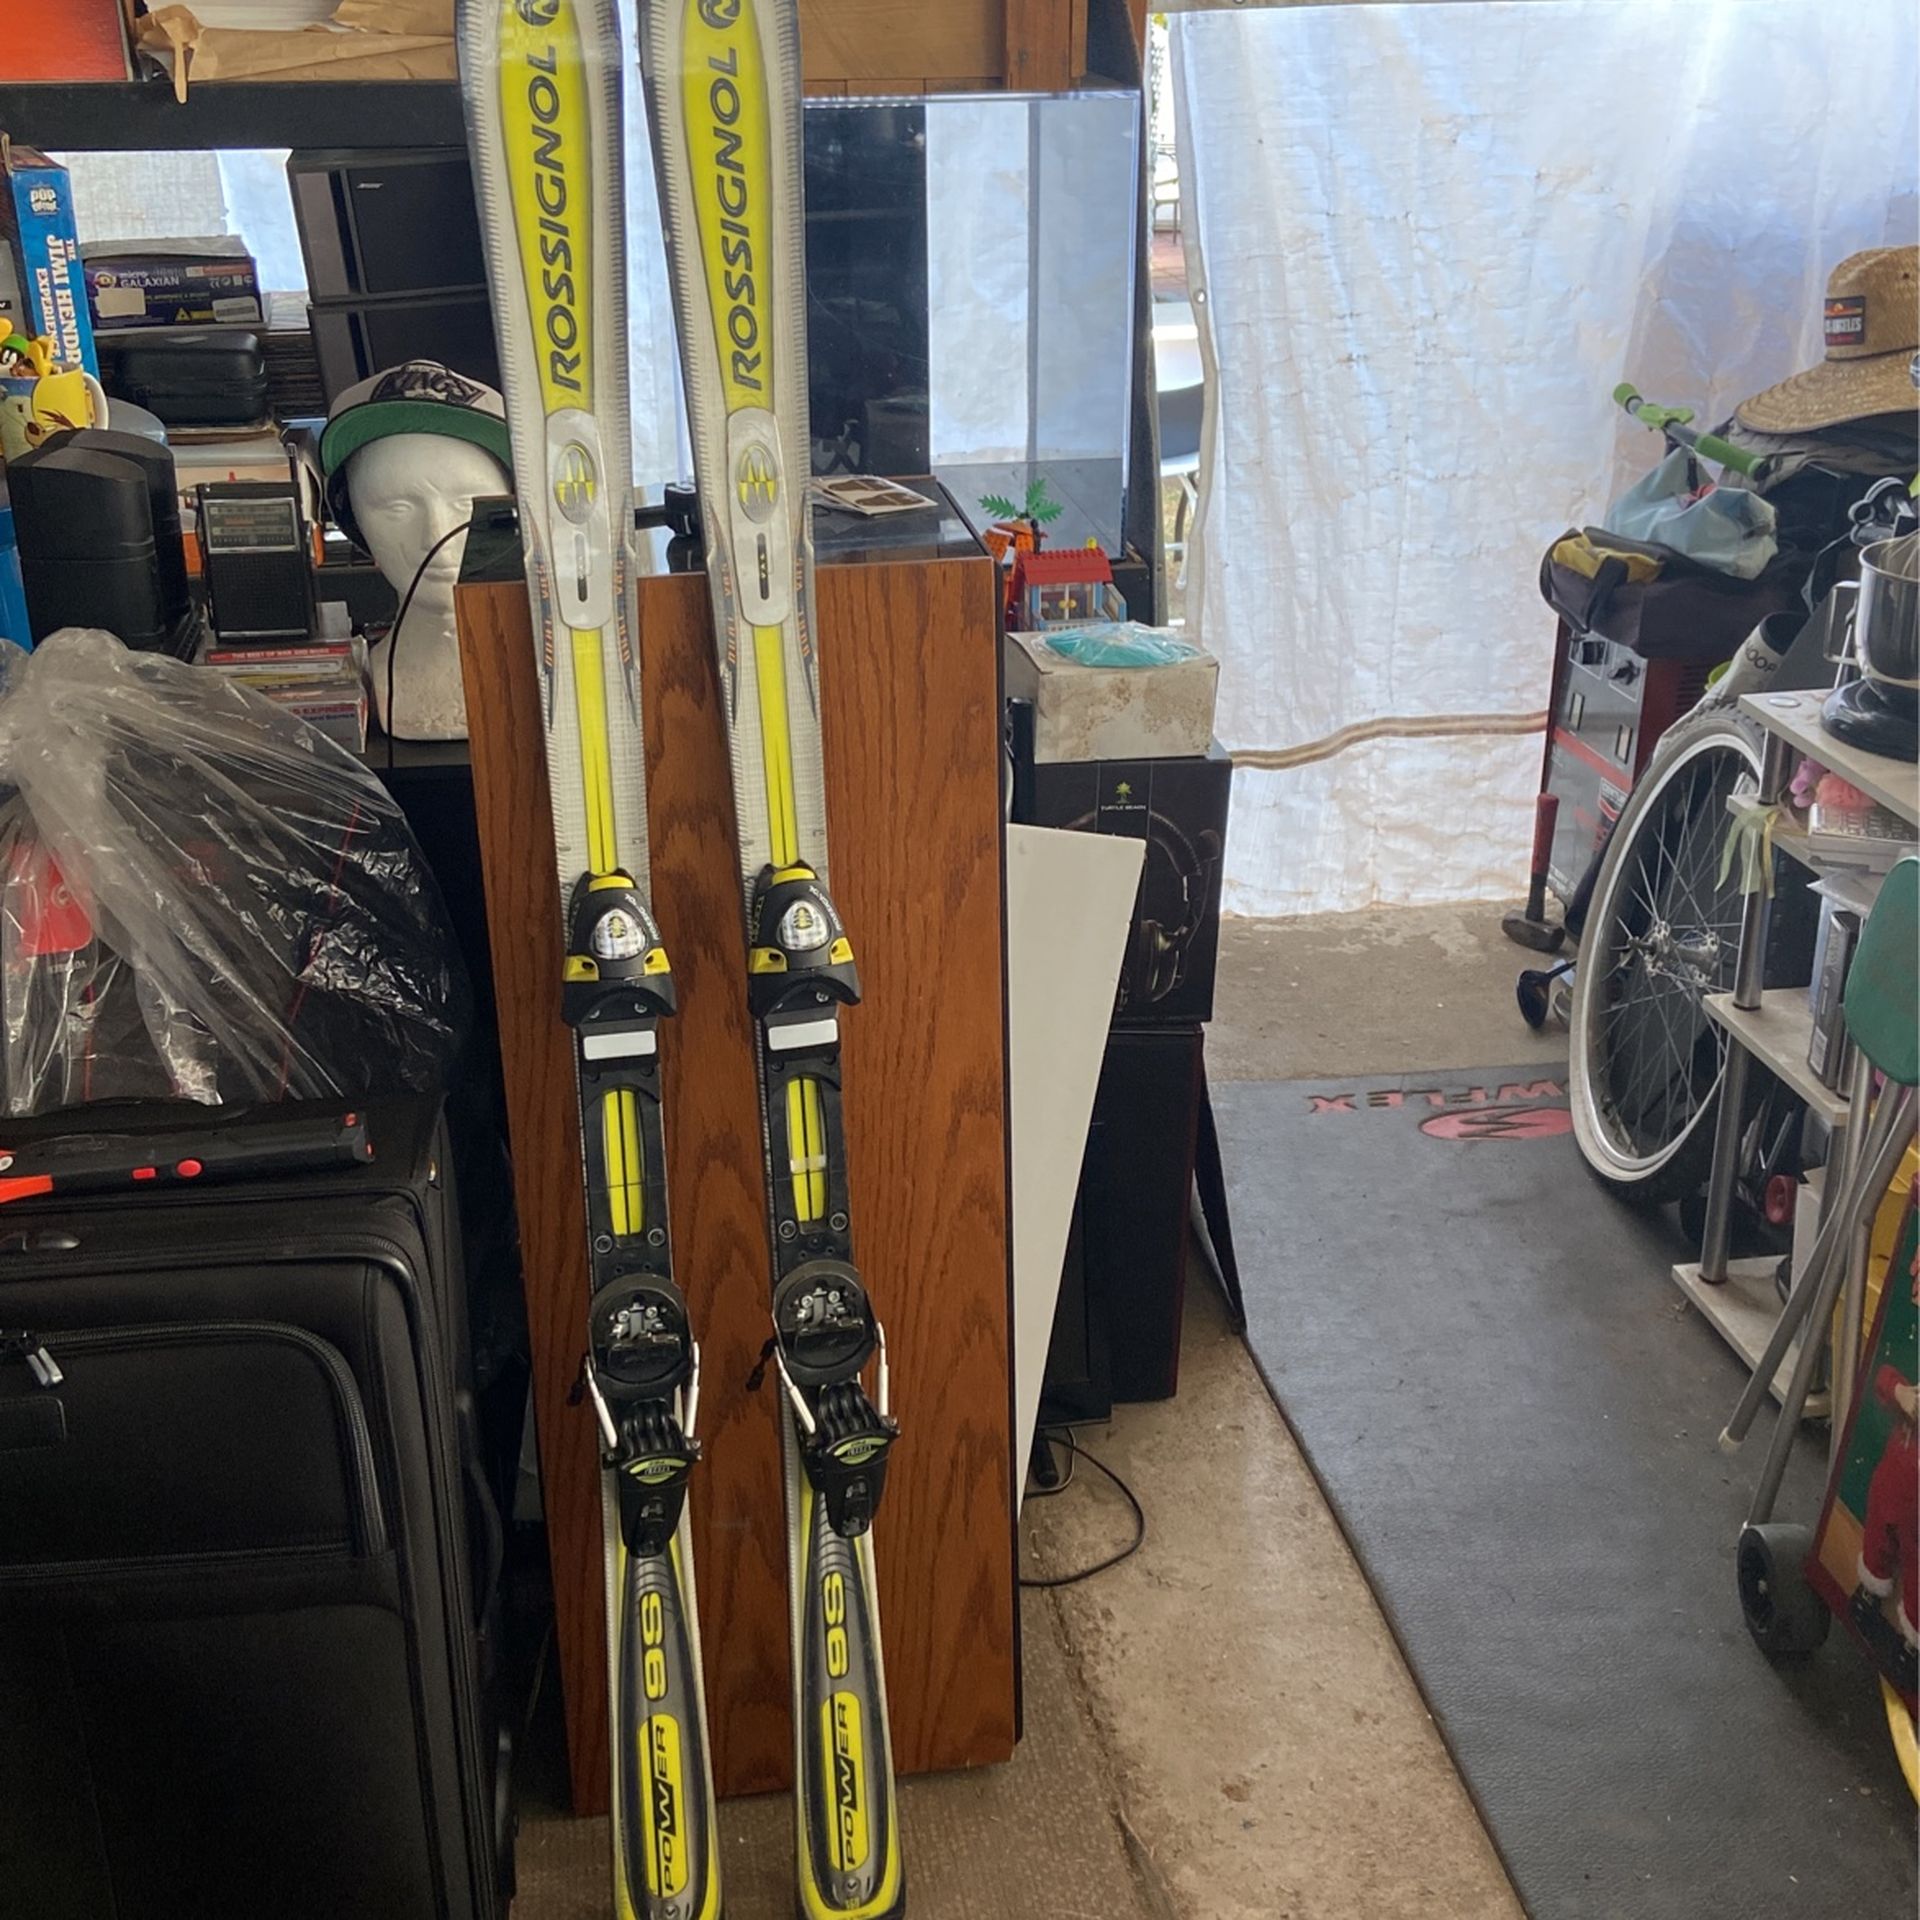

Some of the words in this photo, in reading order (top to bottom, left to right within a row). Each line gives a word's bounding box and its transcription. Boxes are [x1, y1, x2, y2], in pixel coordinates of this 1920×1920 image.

[46, 234, 70, 285] JIMI
[526, 45, 582, 392] ROSSIGNOL
[708, 46, 762, 391] ROSSIGNOL
[55, 288, 83, 364] HENDR
[120, 276, 180, 288] GALAXIAN
[1307, 1078, 1568, 1114] WFLEX
[639, 1590, 669, 1702] 9S
[821, 1570, 851, 1680] 9S
[655, 1723, 677, 1892] POWER
[837, 1701, 858, 1865] POWER
